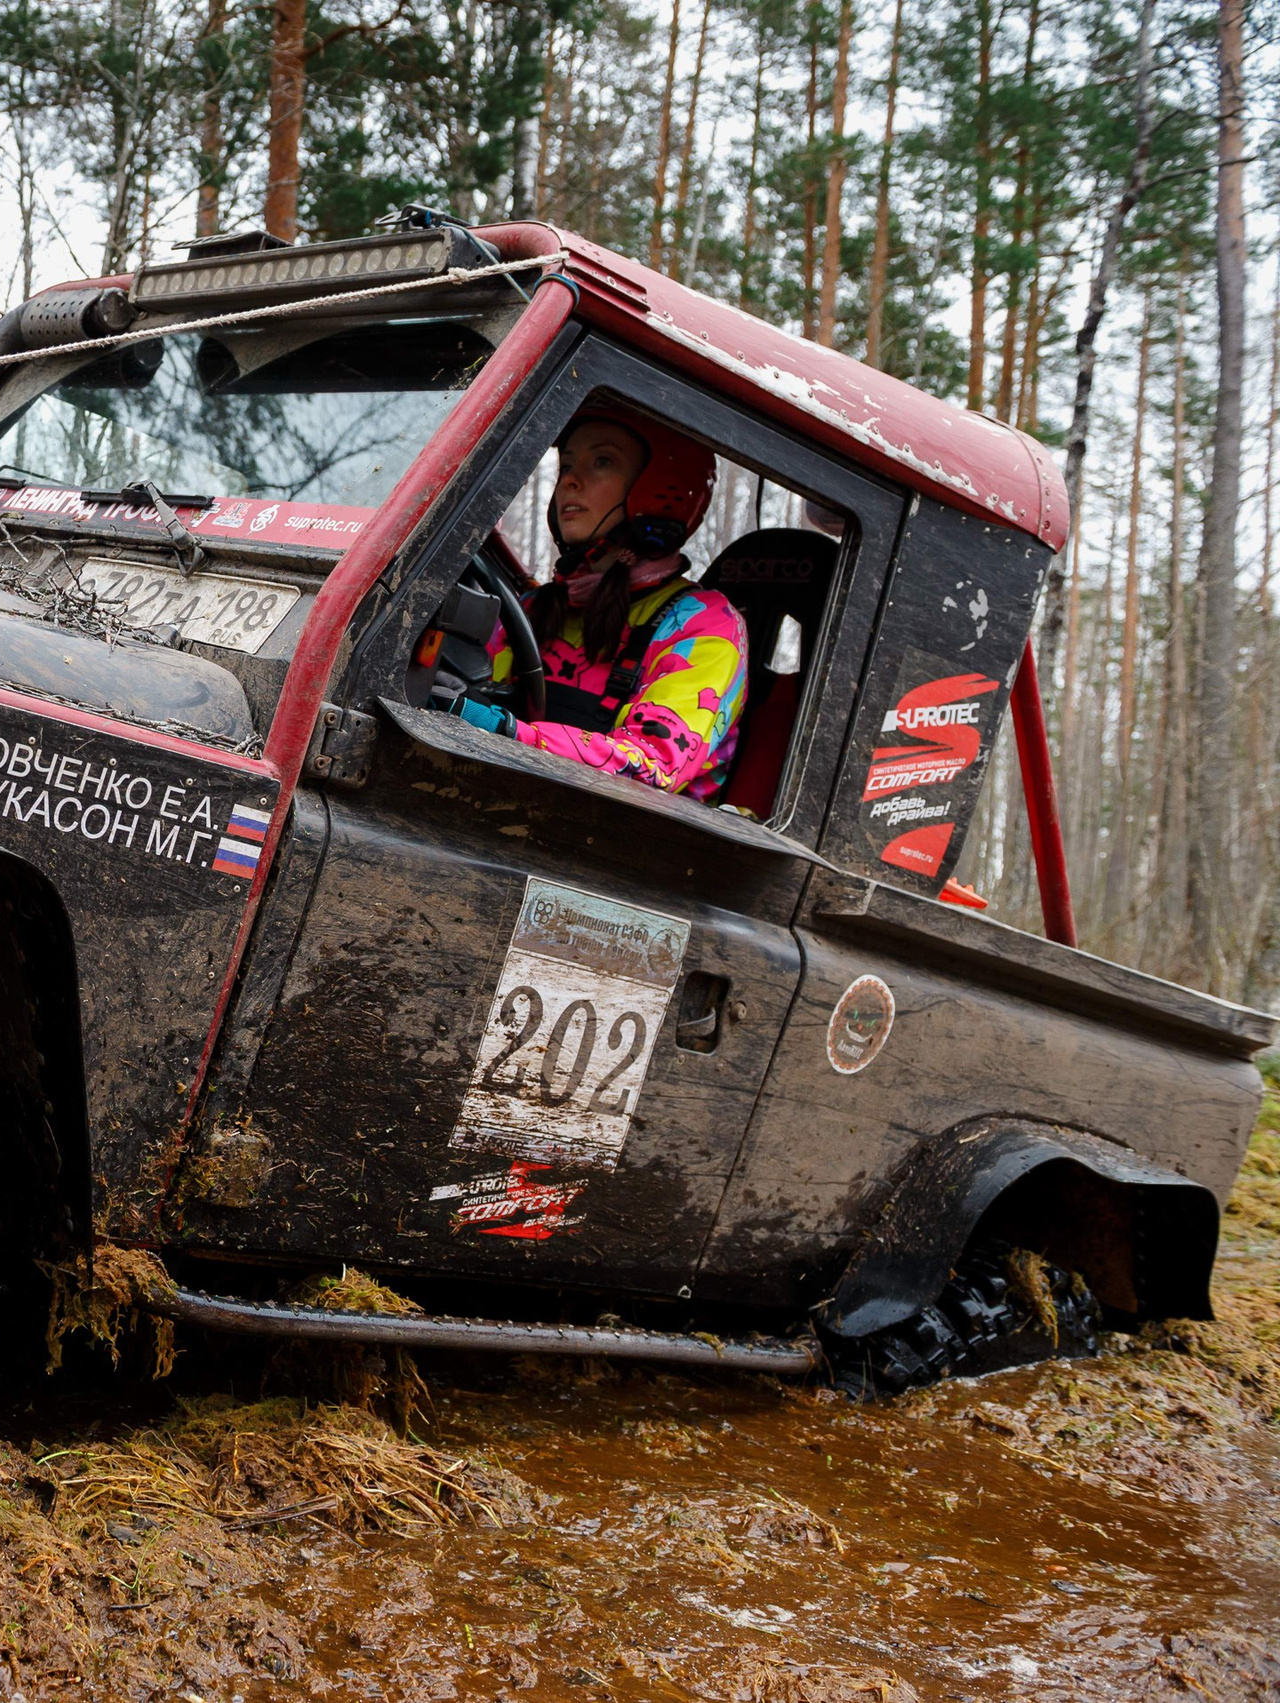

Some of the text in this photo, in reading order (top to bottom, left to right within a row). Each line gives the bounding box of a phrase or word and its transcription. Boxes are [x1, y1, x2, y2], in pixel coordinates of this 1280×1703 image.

[284, 514, 364, 533] suprotec.ru
[720, 556, 814, 582] sparco
[211, 588, 279, 633] 198
[208, 628, 242, 646] RUS
[881, 703, 980, 732] SUPROTEC
[867, 766, 963, 791] COMFORT
[159, 785, 219, 830] Е.А.
[869, 796, 926, 818] добавь
[886, 801, 951, 827] драйва!
[145, 820, 212, 867] М.Г.
[899, 846, 934, 863] suprotec.ru
[481, 985, 648, 1118] 202
